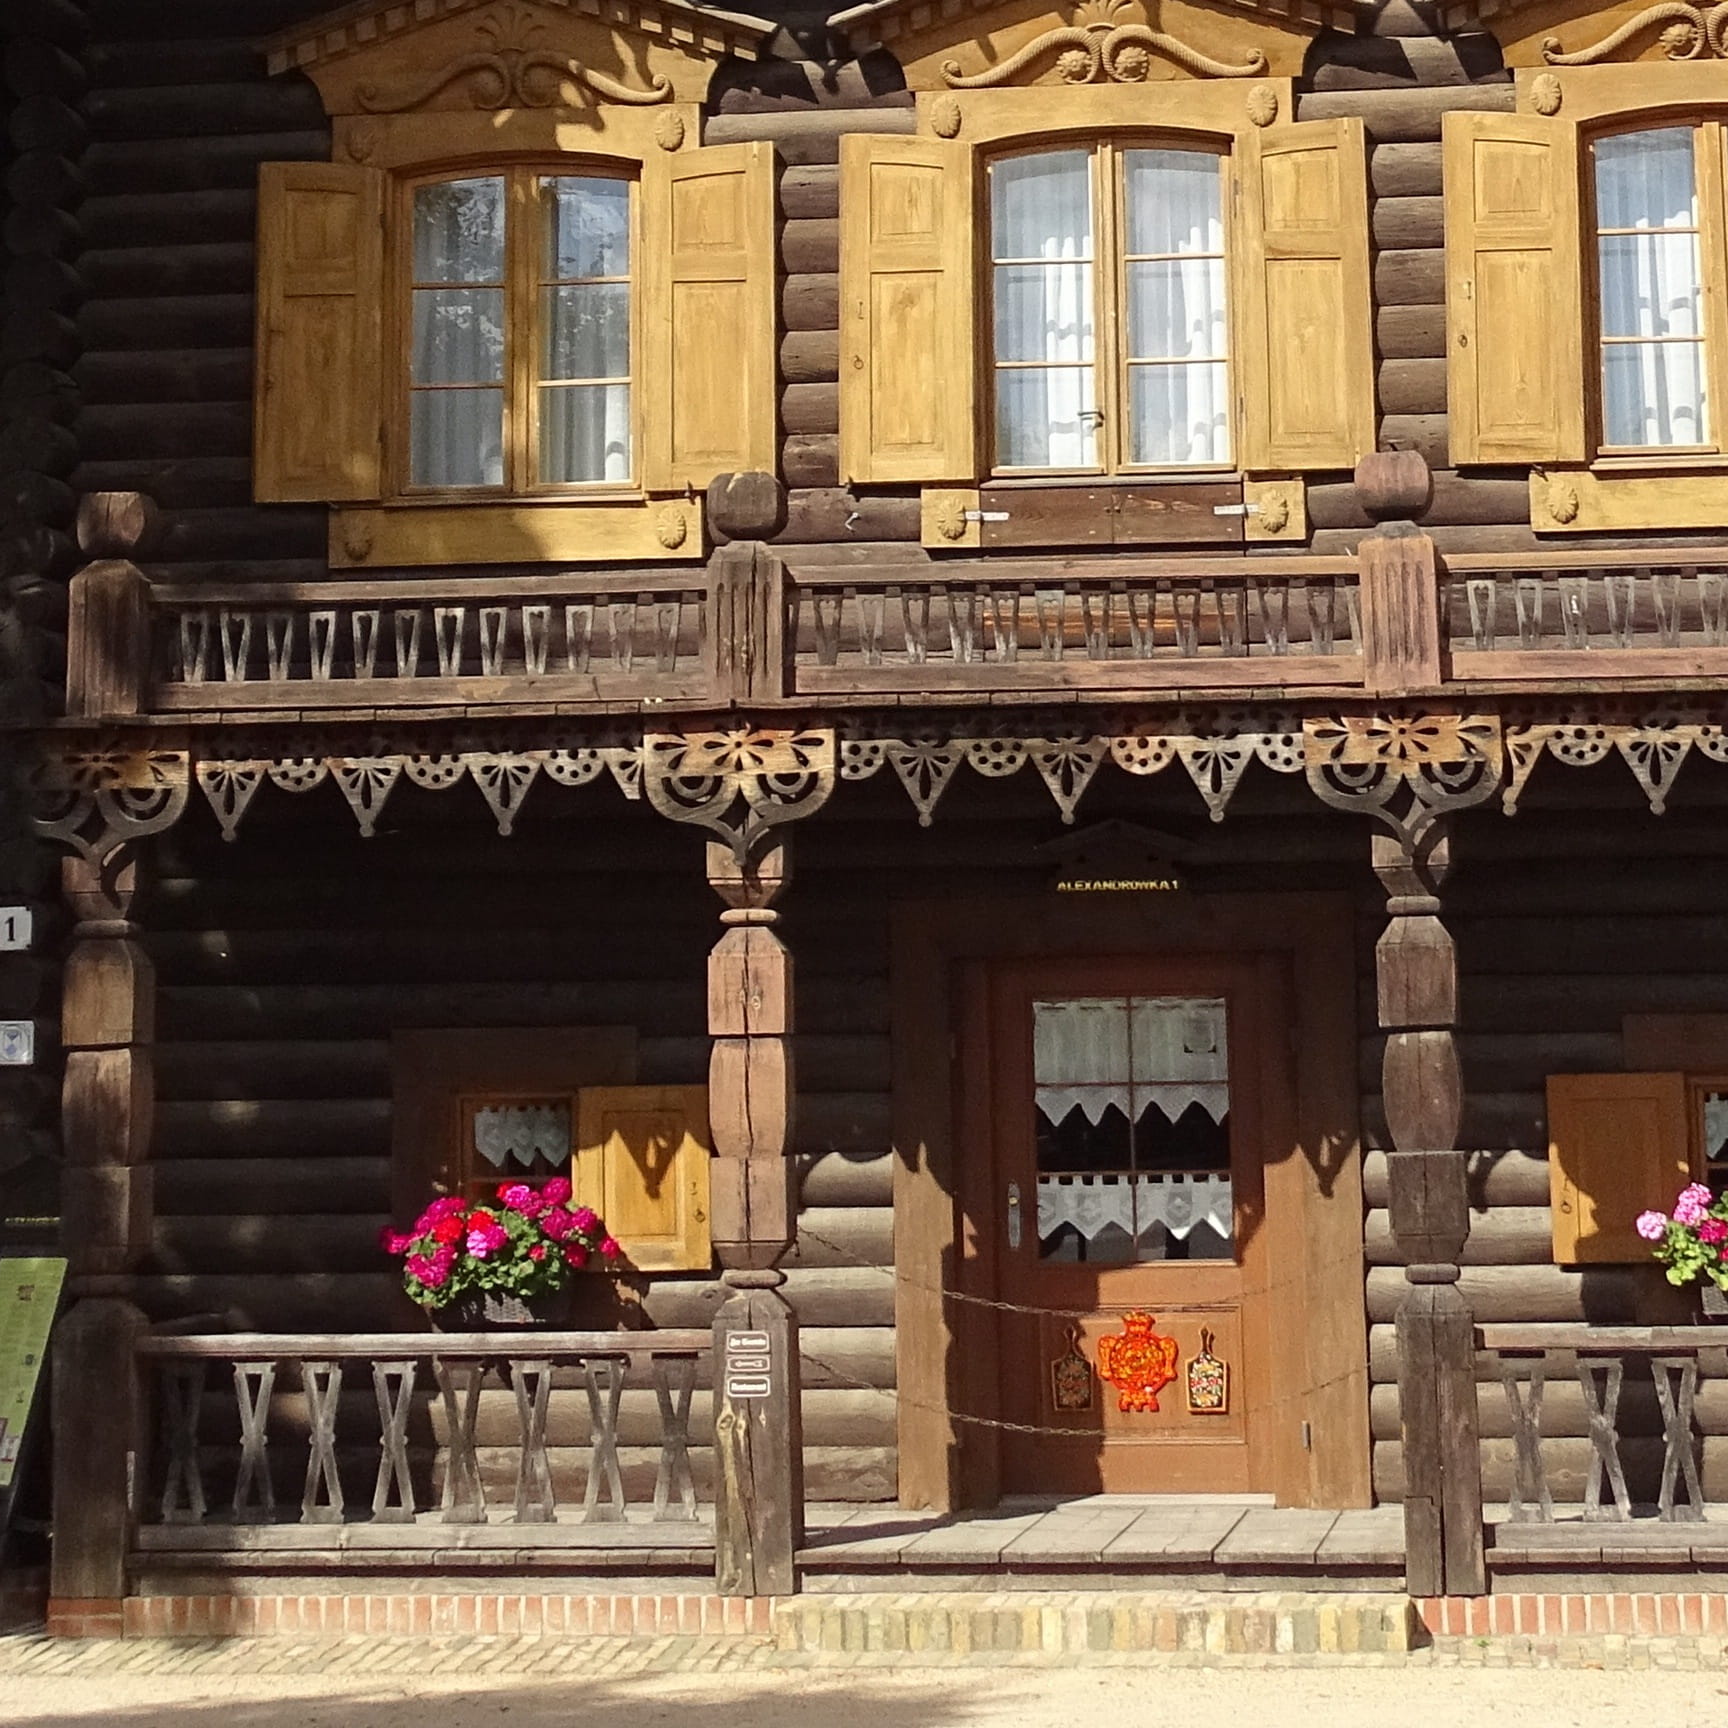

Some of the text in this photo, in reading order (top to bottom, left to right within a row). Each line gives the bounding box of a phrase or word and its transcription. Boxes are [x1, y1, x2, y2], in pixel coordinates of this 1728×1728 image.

[1057, 879, 1179, 891] ALEXANDROWKA 1
[5, 916, 16, 942] 1
